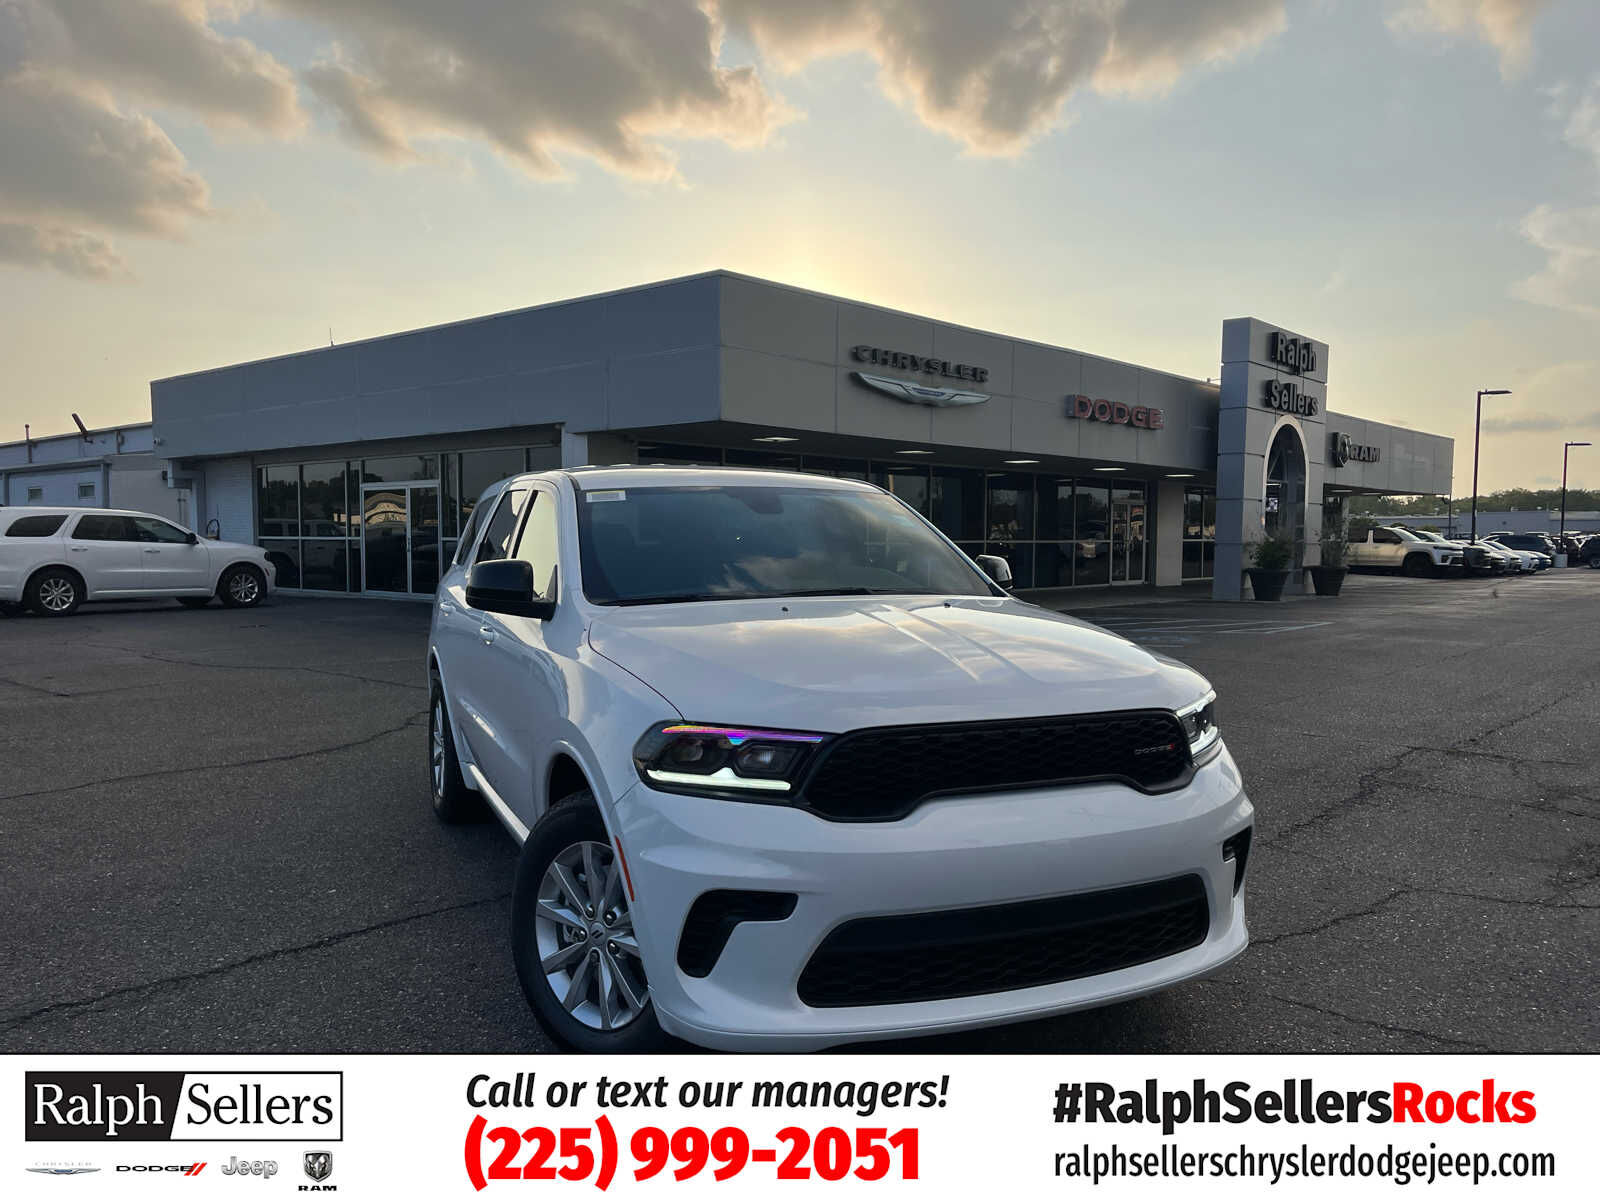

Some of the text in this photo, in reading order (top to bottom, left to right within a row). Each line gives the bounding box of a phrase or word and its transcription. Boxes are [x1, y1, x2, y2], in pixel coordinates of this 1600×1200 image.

[852, 345, 990, 382] CHRYSLER
[1272, 331, 1317, 374] Ralph
[1067, 394, 1165, 430] DODGE
[1268, 379, 1319, 416] Sellers
[1350, 444, 1381, 463] RAM
